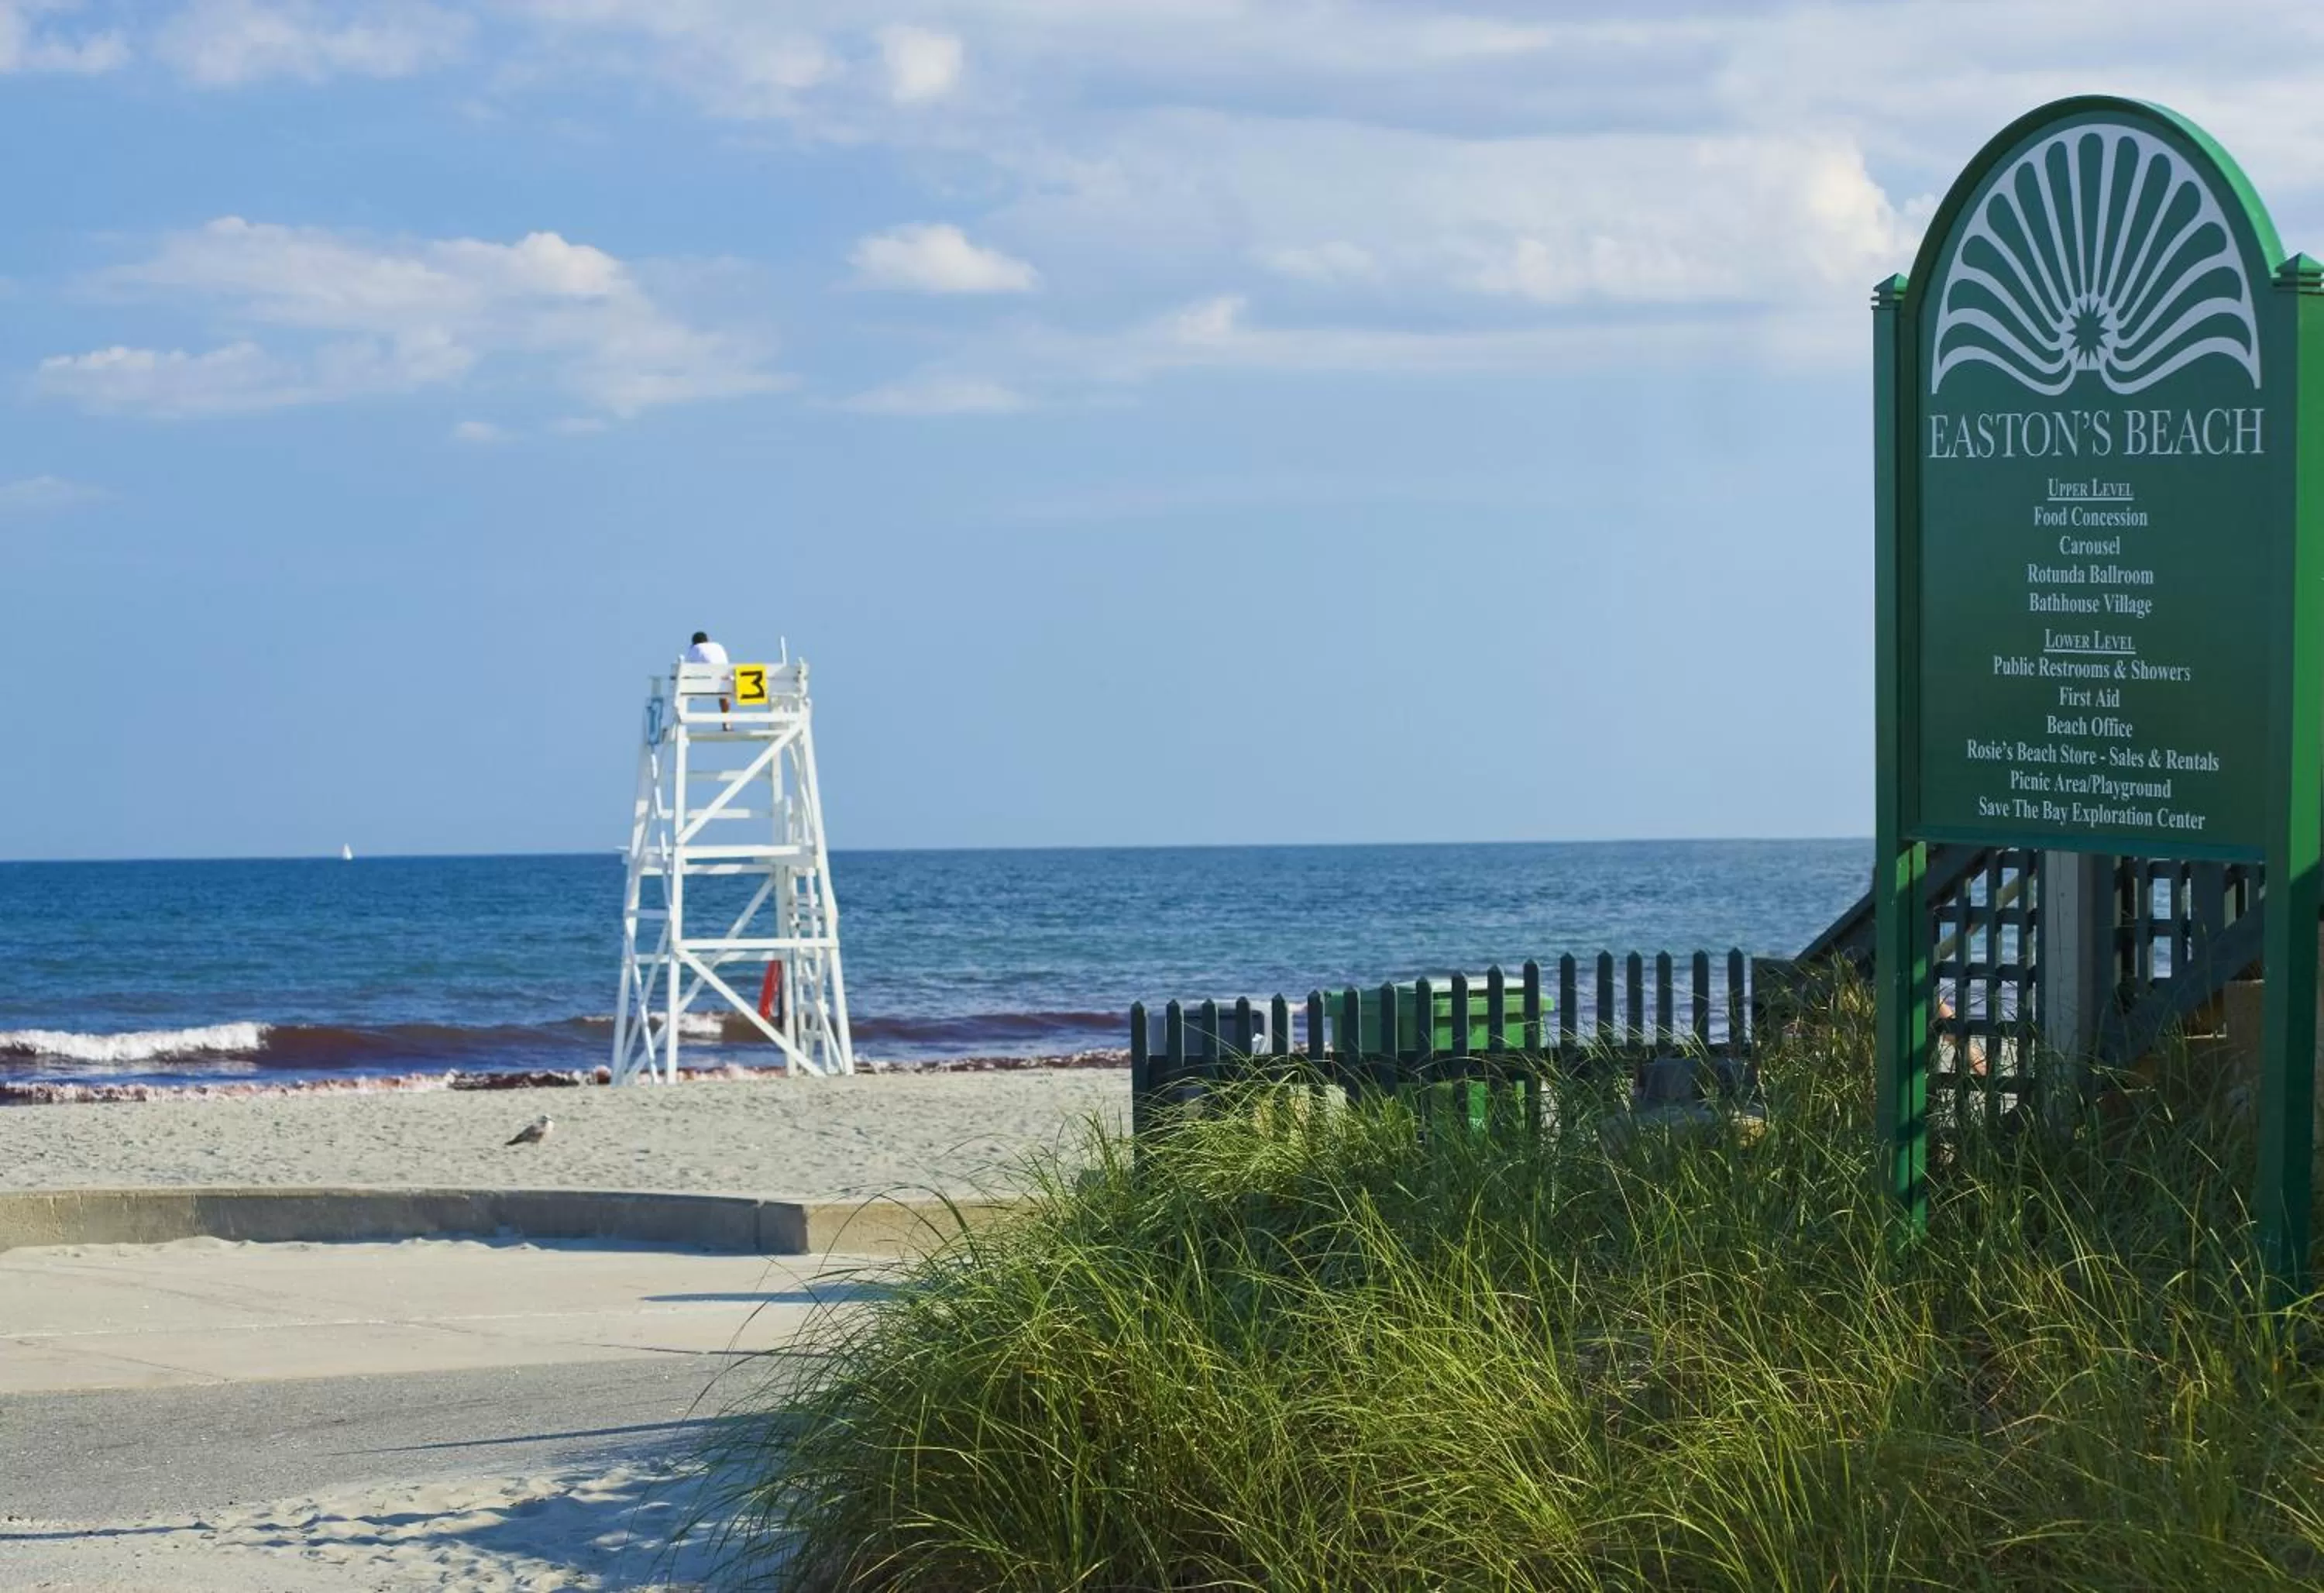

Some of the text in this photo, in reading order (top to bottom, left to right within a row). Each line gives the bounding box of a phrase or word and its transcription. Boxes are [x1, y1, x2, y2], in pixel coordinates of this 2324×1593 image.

[1928, 408, 2265, 459] EASTON'S BEACH
[2033, 506, 2148, 527] Food Concession
[2059, 535, 2121, 556] Carousel
[2027, 564, 2154, 585] Rotunda Ballroom
[2029, 593, 2153, 619] Bathhouse Village
[1993, 655, 2192, 682] Public Restrooms & Showers
[740, 670, 765, 699] 3
[2059, 686, 2120, 708] First Aid
[2047, 715, 2133, 738] Beach Office
[1966, 739, 2013, 762] Rosie's
[2017, 741, 2058, 764] Beach
[2060, 745, 2097, 766] Store
[2109, 747, 2144, 768] Sales
[2147, 748, 2163, 769] &
[2166, 748, 2220, 772] Rentals
[2010, 770, 2172, 801] Picnic Area/Playground
[1978, 796, 2206, 831] Save The Bay Exploration Center
